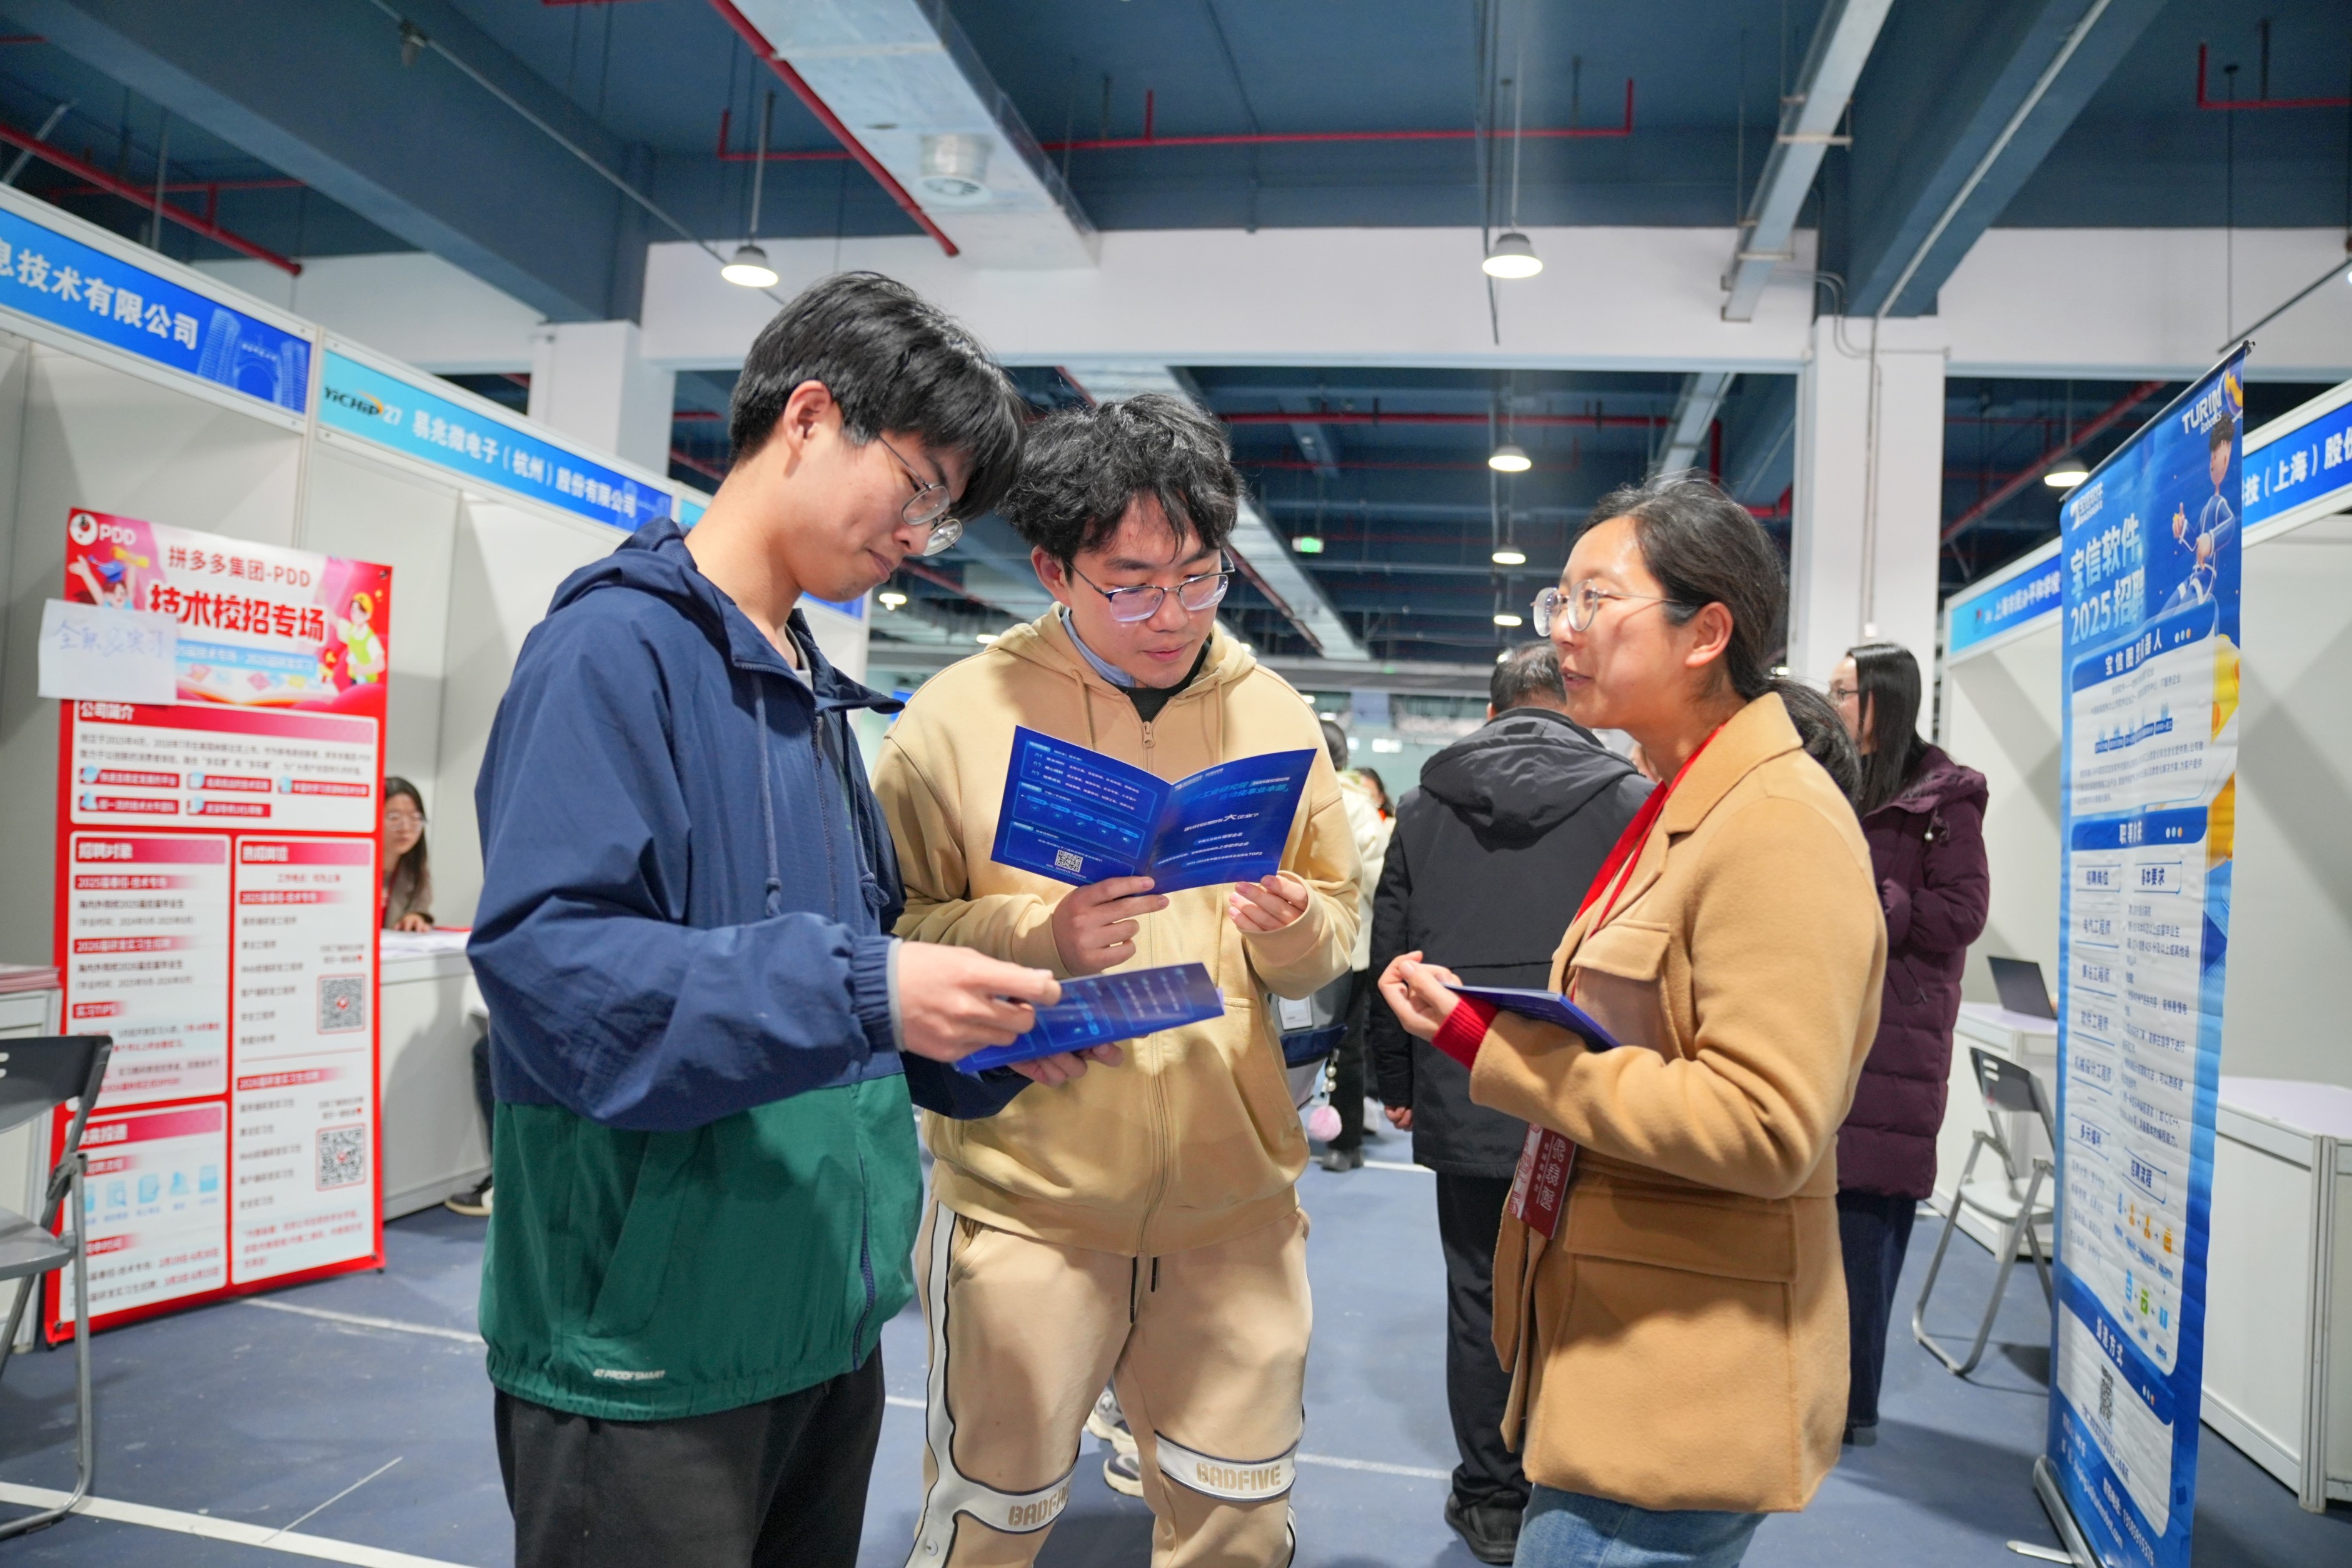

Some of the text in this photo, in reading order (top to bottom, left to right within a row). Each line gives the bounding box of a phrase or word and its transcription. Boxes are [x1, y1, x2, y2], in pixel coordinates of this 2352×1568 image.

[2181, 384, 2223, 435] TURIN
[99, 523, 137, 546] PDD
[2070, 513, 2141, 597] 宝信软件
[168, 545, 311, 588] 拼多多集团-PDD
[150, 584, 325, 643] 技术校招专场
[1539, 1137, 1566, 1212] 代表证
[1196, 1461, 1281, 1491] BADFIVE
[1007, 1480, 1071, 1527] BADFIV
